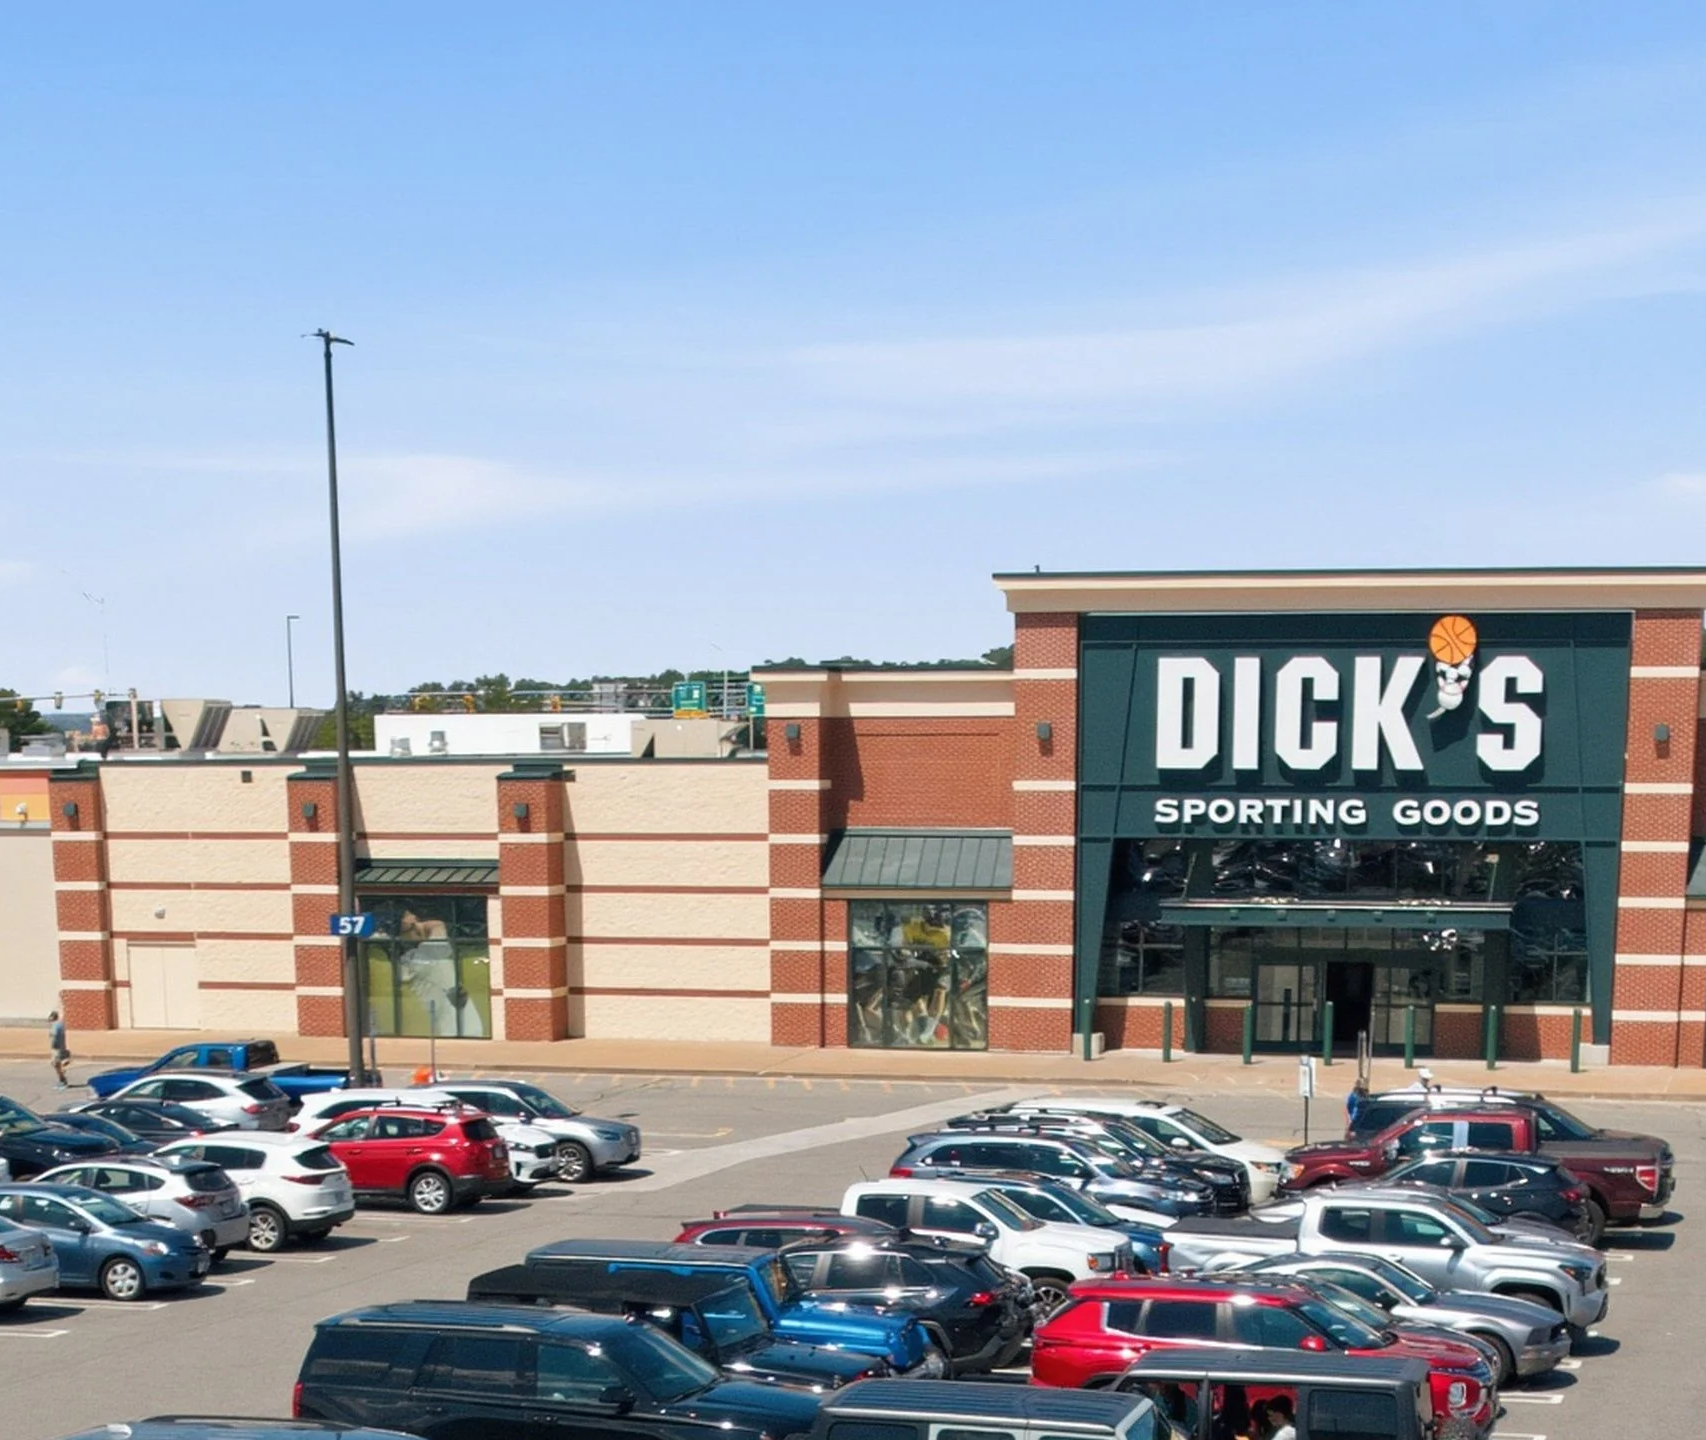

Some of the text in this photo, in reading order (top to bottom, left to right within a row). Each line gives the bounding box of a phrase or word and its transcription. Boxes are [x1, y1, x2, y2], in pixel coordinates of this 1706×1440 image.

[1156, 650, 1544, 771] DICK'S
[1154, 798, 1540, 827] SPORTING GOODS
[338, 916, 365, 934] 57
